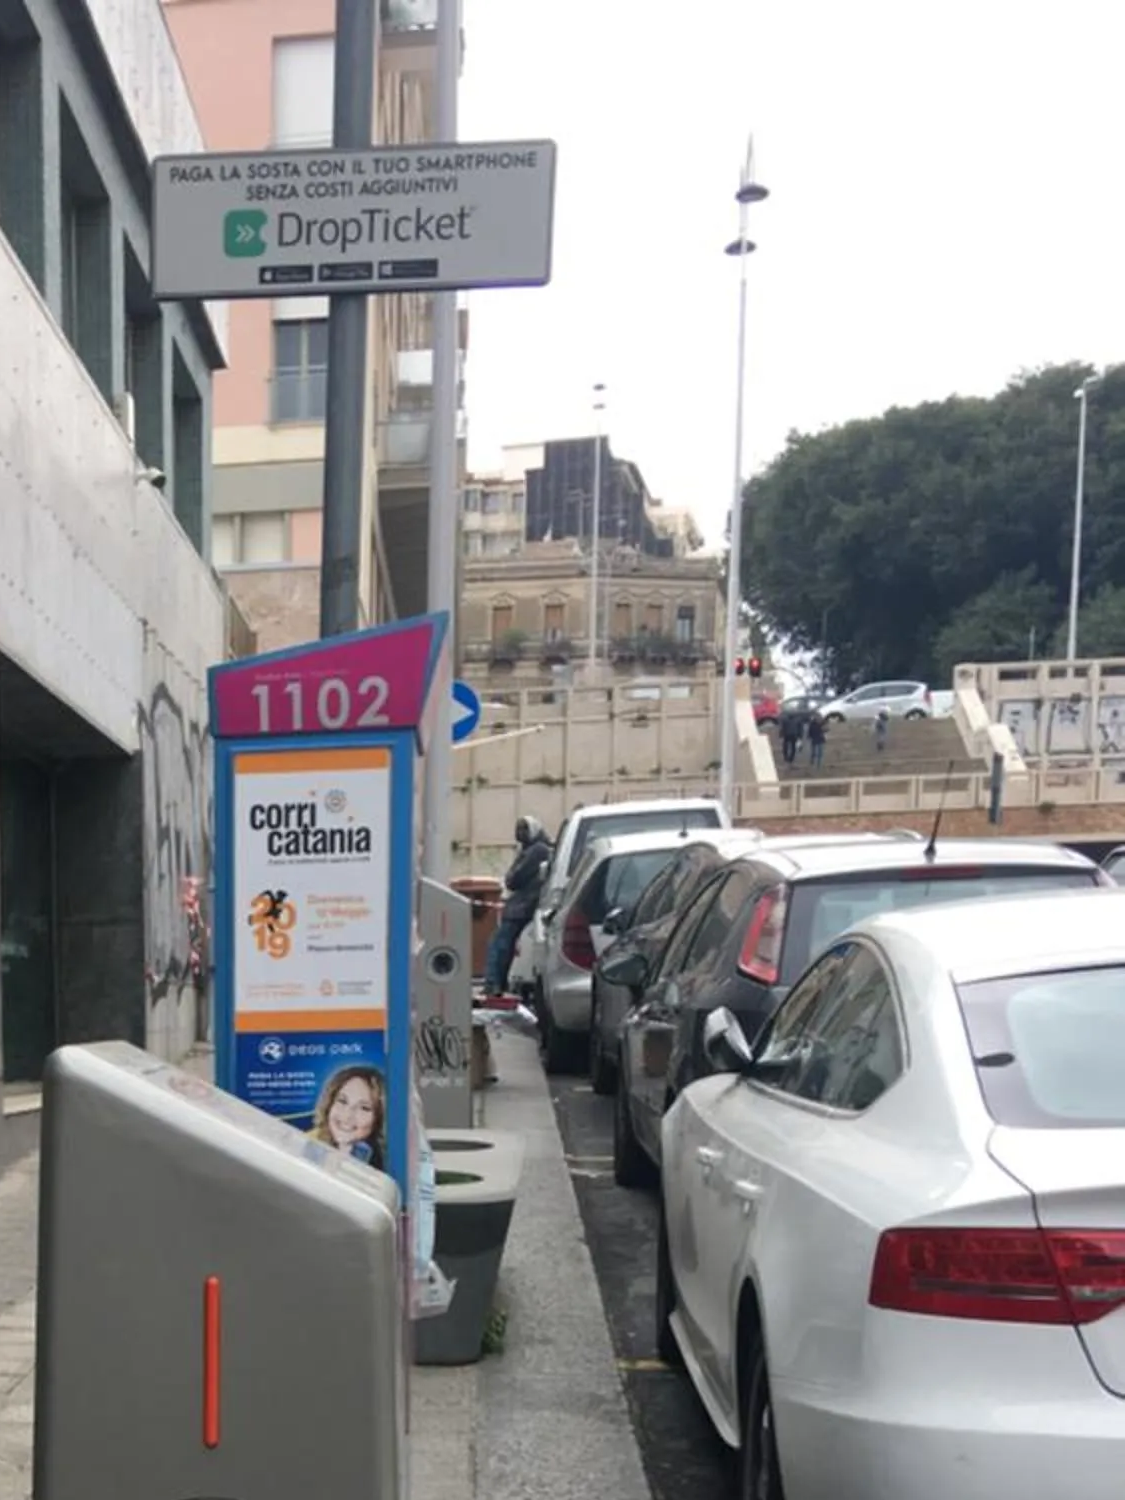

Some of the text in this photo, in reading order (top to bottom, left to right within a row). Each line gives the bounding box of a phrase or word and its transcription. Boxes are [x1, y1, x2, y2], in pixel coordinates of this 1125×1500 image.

[169, 151, 538, 183] PAGA LA SOSTA CON IL TUO SMARTPHONE
[246, 177, 458, 201] SENZA COSTI AGGIUNTIVI
[277, 206, 472, 254] DropTicket
[250, 675, 390, 732] 1102
[249, 802, 317, 831] corri
[267, 824, 372, 857] catania
